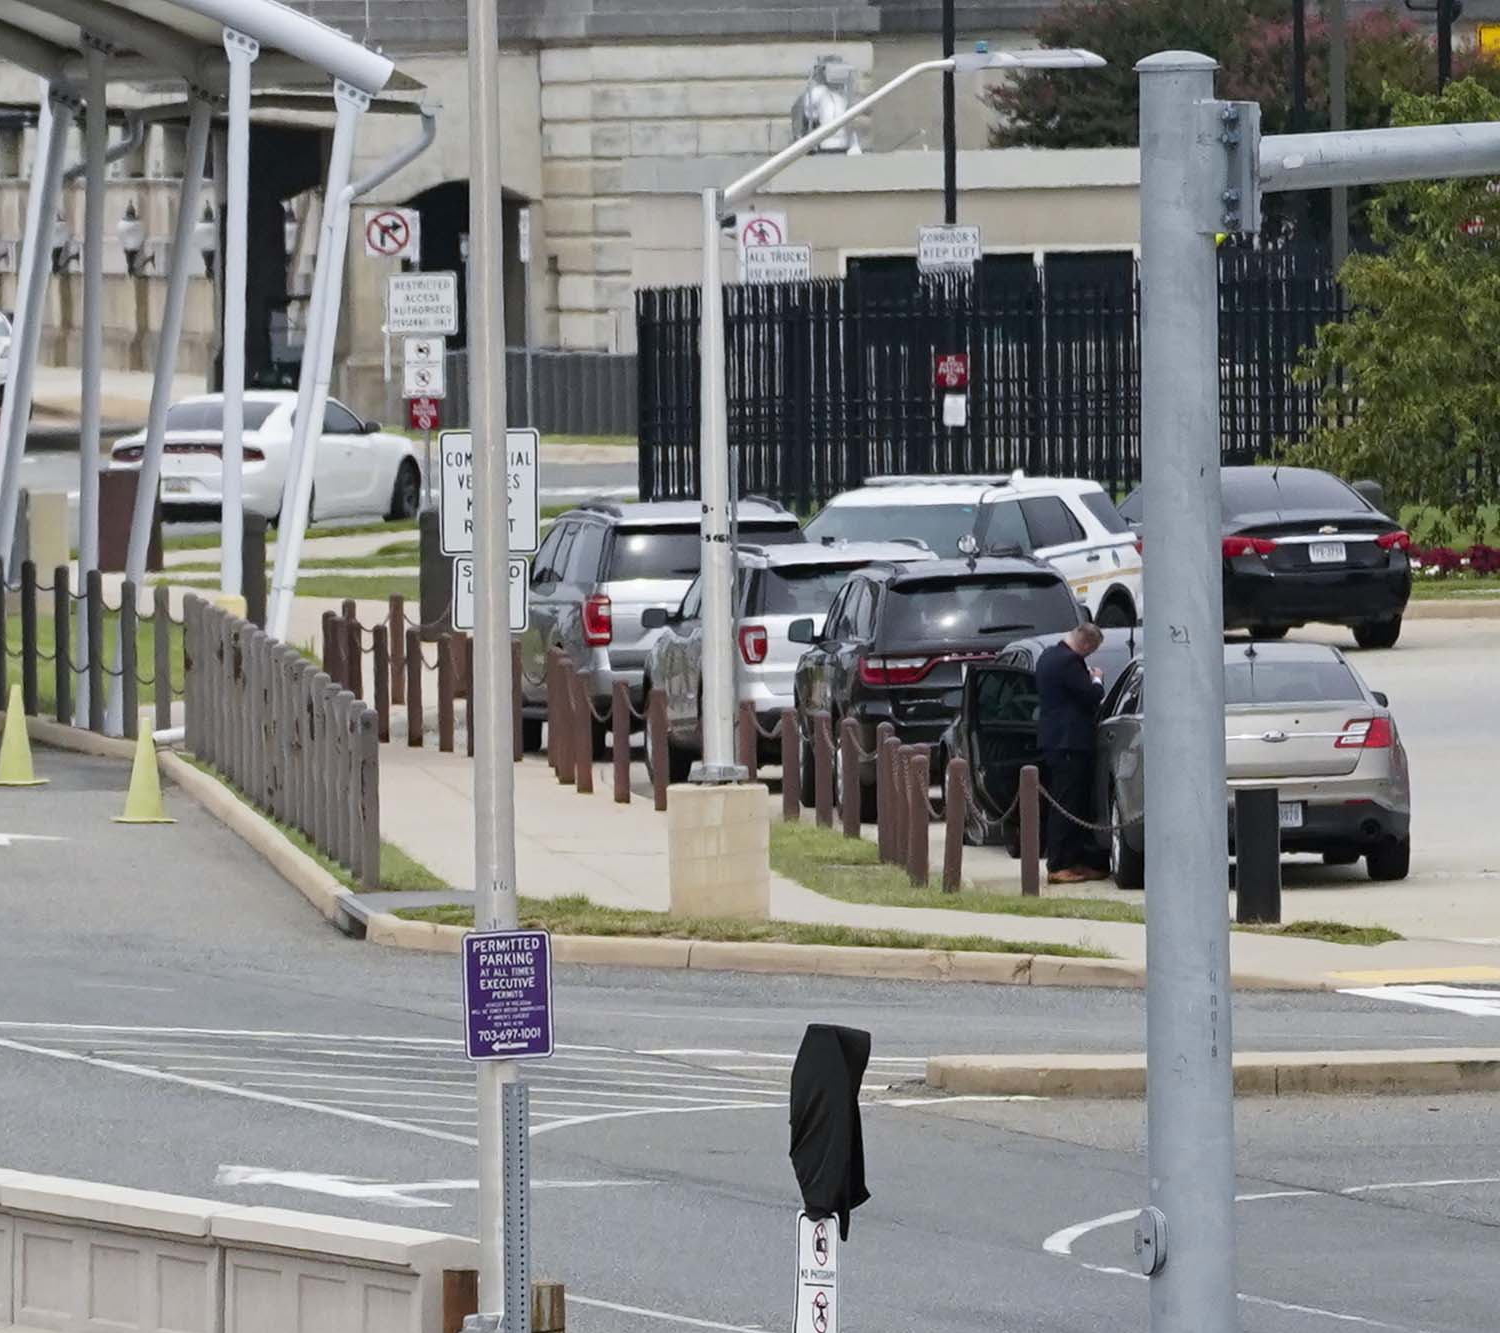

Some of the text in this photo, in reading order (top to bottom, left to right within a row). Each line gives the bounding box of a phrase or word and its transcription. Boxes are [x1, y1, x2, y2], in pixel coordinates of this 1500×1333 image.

[446, 451, 532, 466] COMIAL
[472, 937, 540, 953] PERMITTED
[479, 952, 534, 966] PARKING
[479, 966, 535, 978] AT ALL TIMES
[479, 977, 536, 991] EXECUTIVE
[491, 990, 524, 1000] PERMITS
